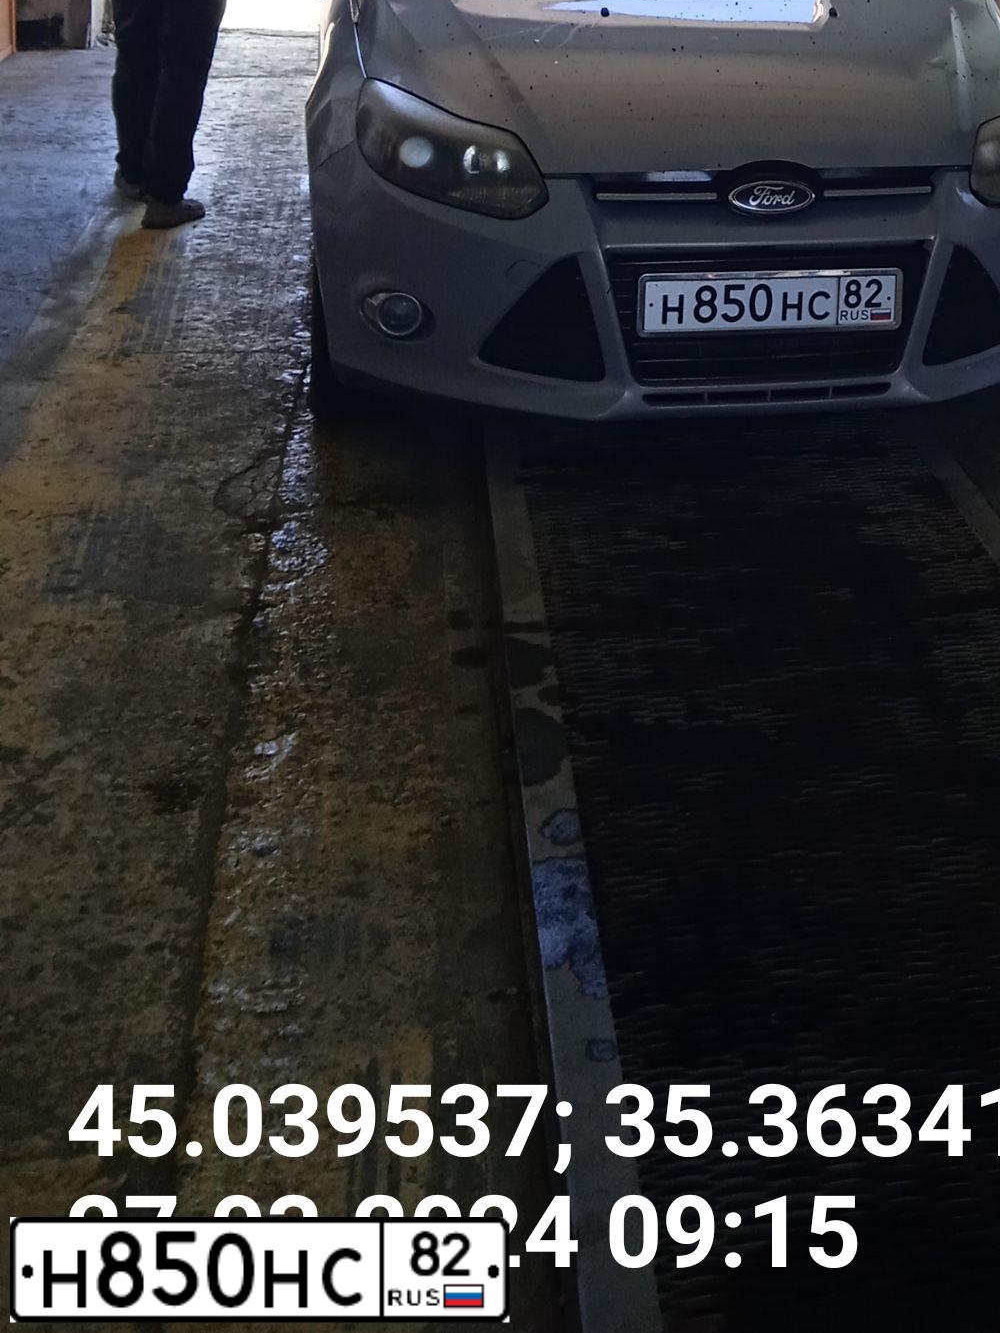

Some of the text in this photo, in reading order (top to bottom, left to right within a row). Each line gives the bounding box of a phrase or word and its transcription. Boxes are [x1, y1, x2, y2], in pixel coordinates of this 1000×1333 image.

[748, 185, 796, 207] Ford
[843, 278, 883, 309] 82
[839, 309, 869, 322] RUS
